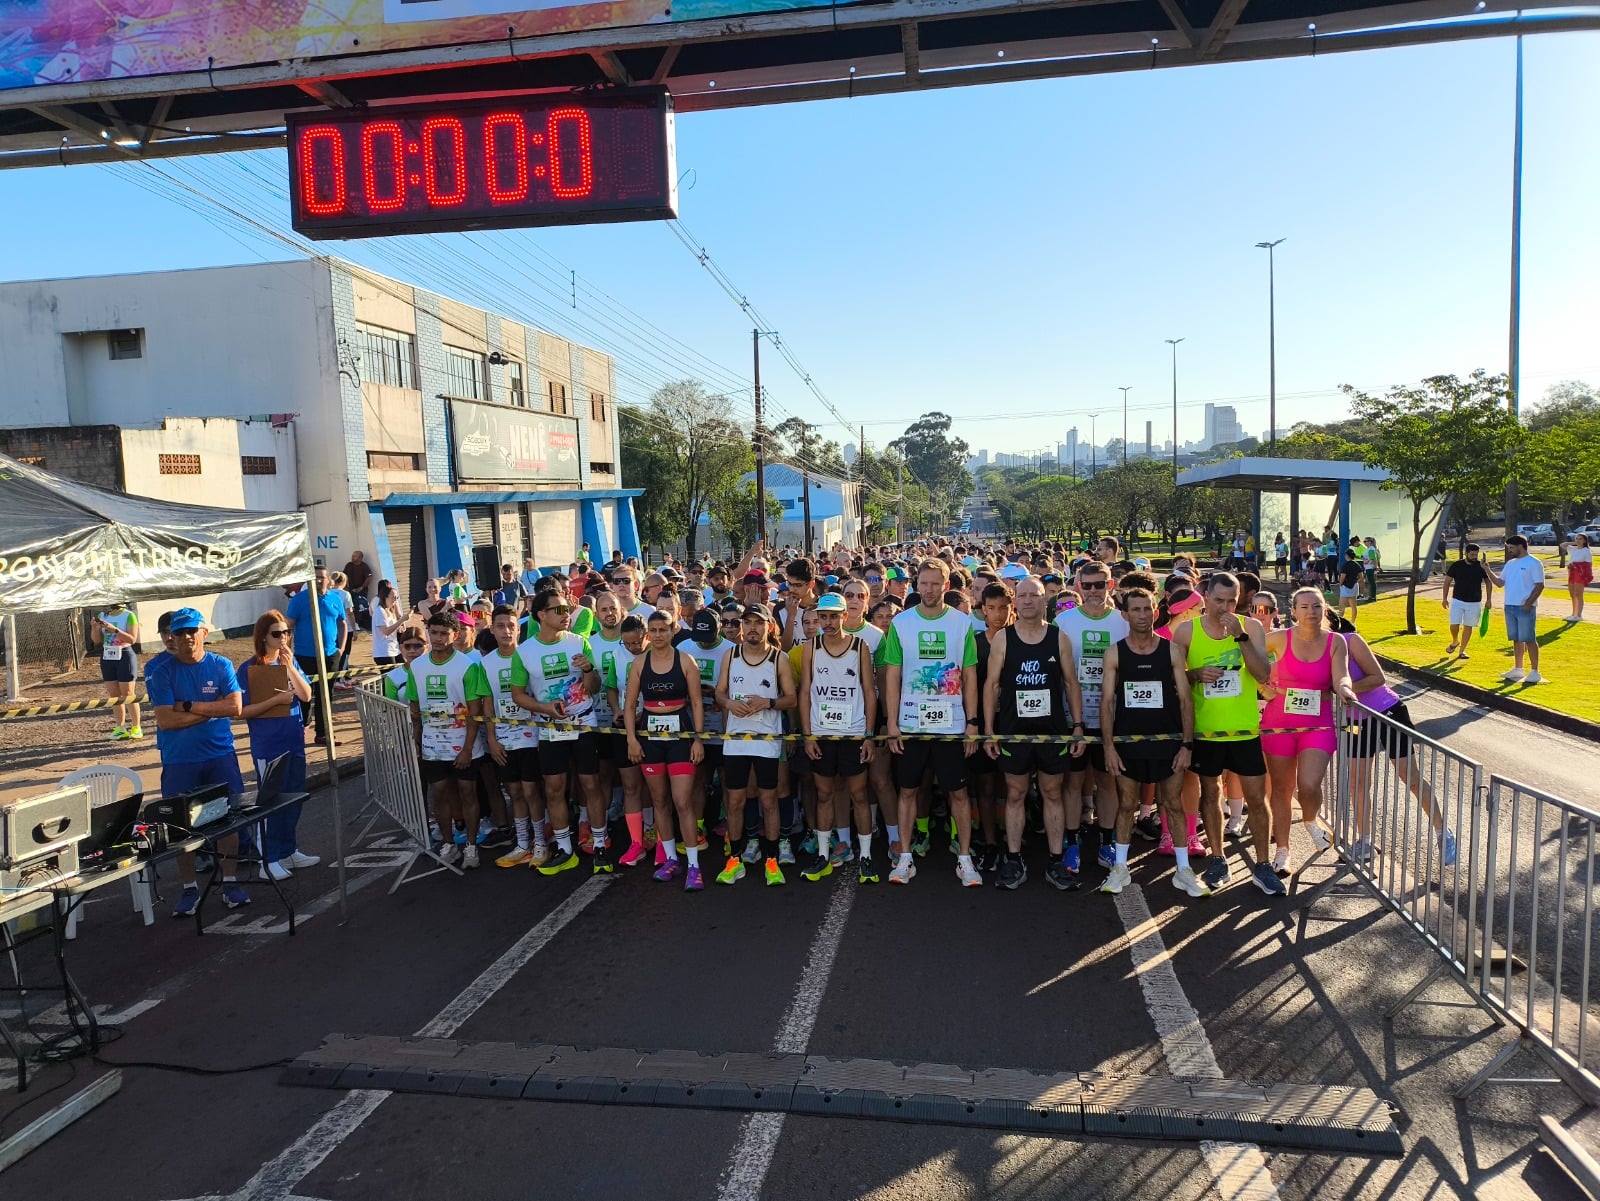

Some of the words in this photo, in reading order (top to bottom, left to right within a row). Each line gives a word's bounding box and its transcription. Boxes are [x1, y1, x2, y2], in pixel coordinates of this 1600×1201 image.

[1020, 660, 1040, 673] NEO
[1085, 667, 1103, 675] 329
[1016, 672, 1048, 686] SAÚDE
[648, 682, 674, 690] UPPER
[816, 686, 856, 697] WEST
[1132, 690, 1152, 699] 328
[1023, 699, 1041, 708] 482
[1291, 697, 1309, 706] 218
[825, 712, 843, 720] 446
[925, 711, 944, 719] 438
